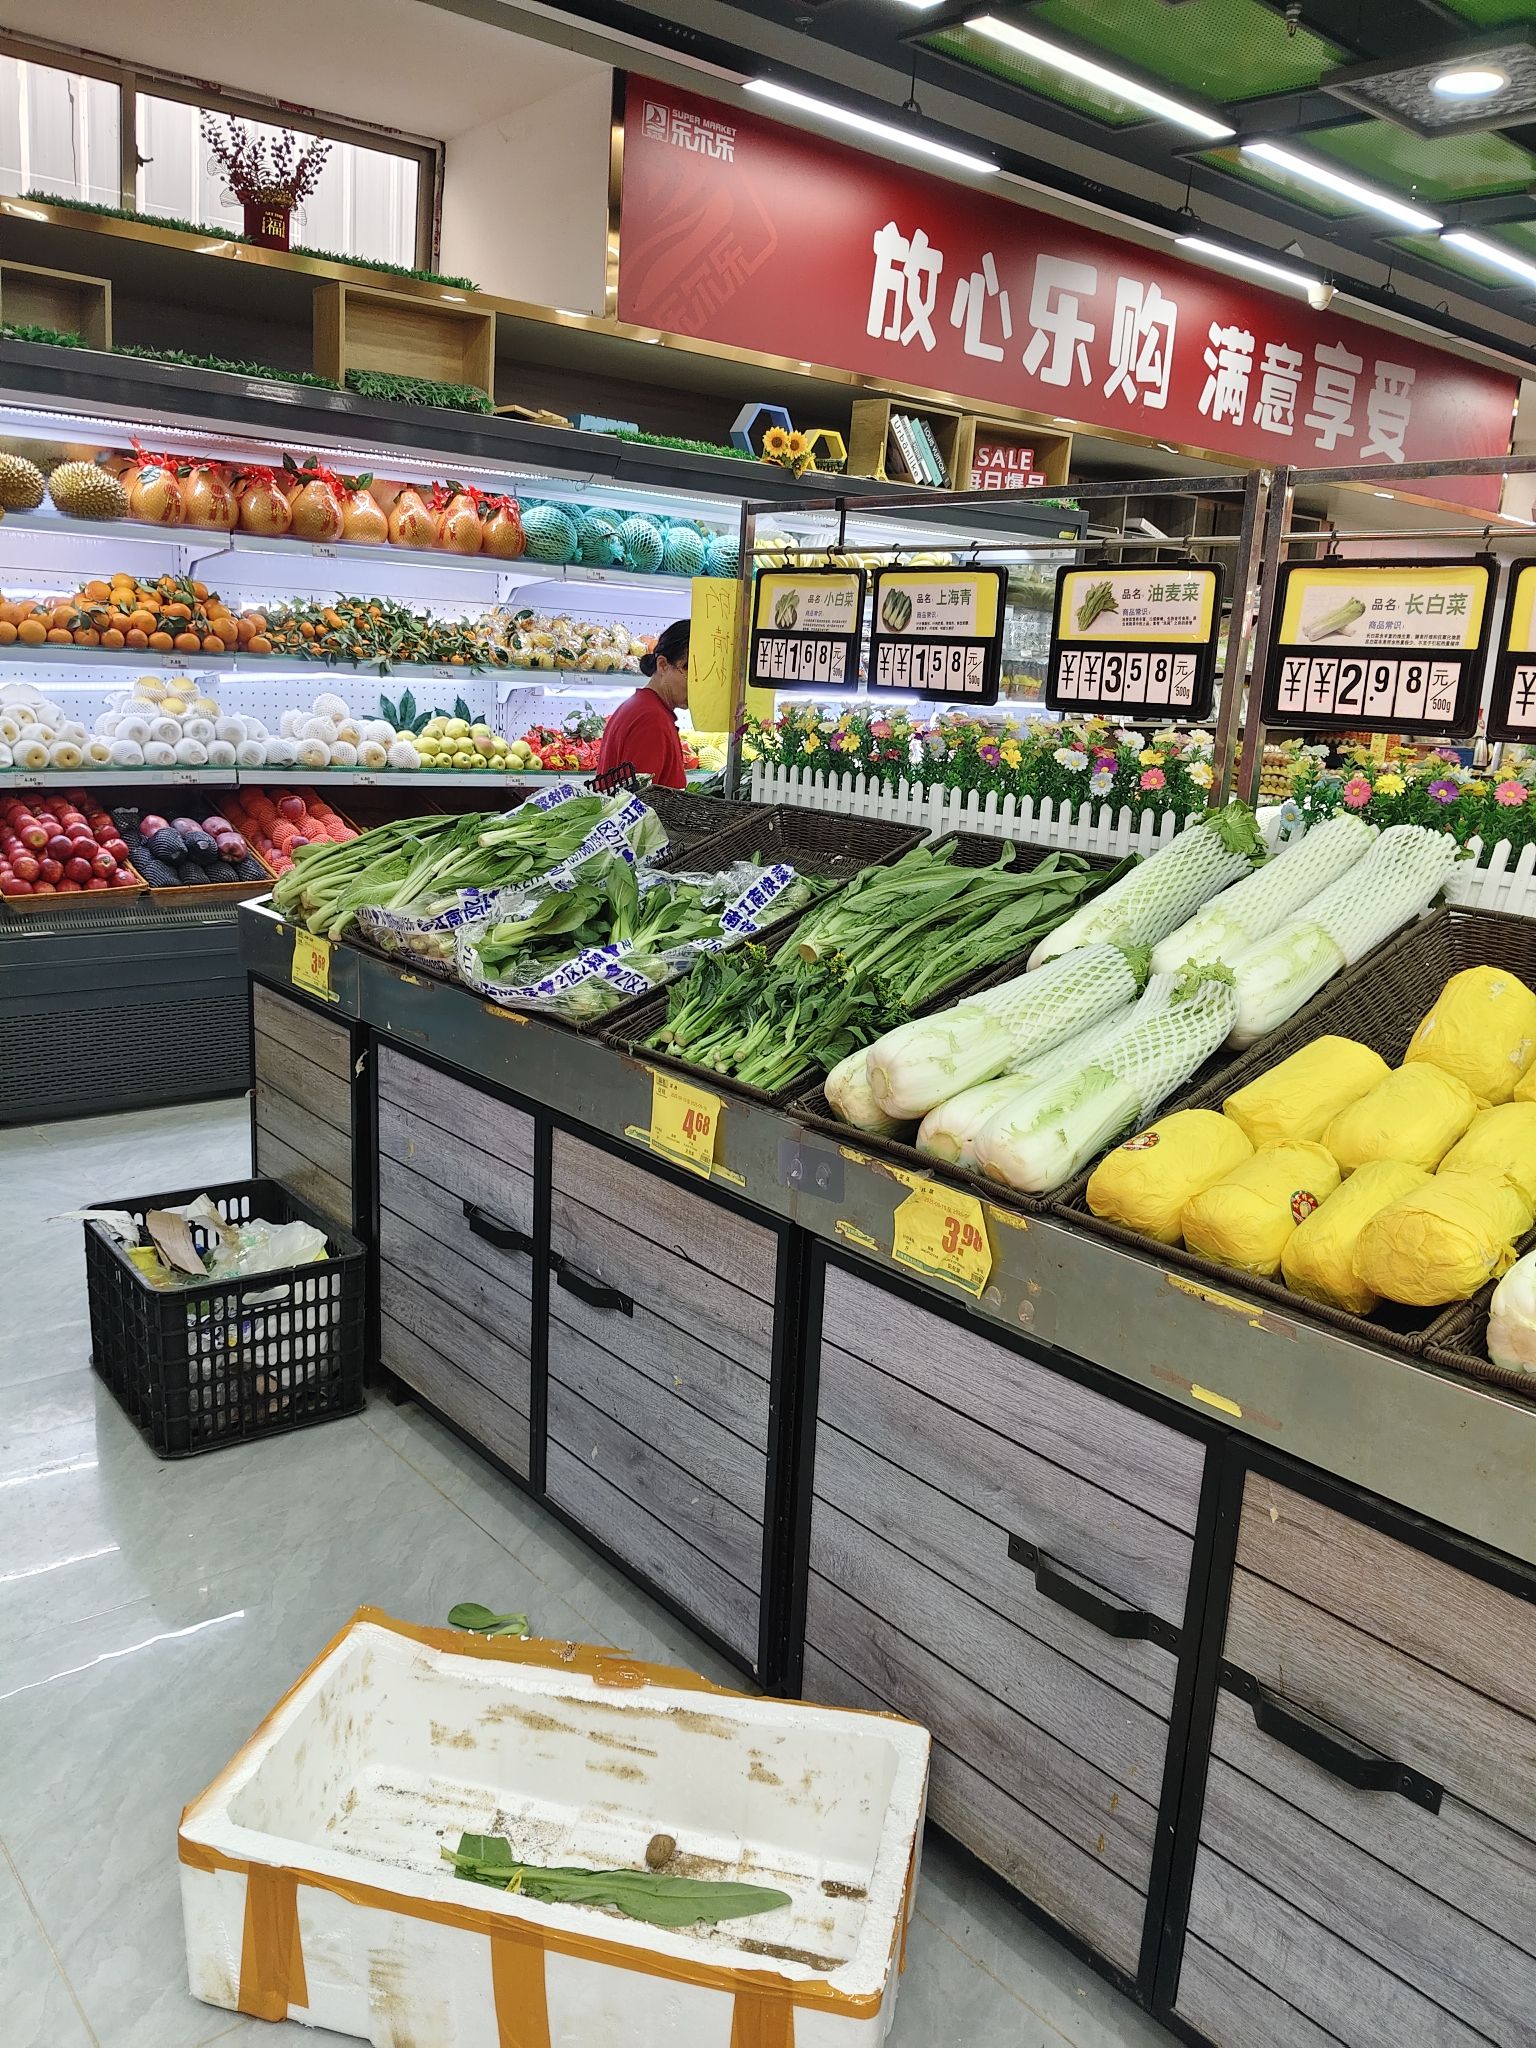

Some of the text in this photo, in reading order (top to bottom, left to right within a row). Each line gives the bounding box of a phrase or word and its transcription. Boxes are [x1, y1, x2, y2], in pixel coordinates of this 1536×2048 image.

[672, 108, 737, 136] SUPER MARKET
[866, 221, 1417, 464] 放心乐购 满意享受
[977, 447, 1032, 471] SALE
[823, 591, 855, 607] 小白菜
[936, 588, 972, 606] 上海青
[1147, 582, 1200, 603] 油麦菜
[1404, 593, 1469, 616] 长白菜
[682, 1108, 711, 1142] 4.68
[941, 1216, 983, 1256] 3.98
